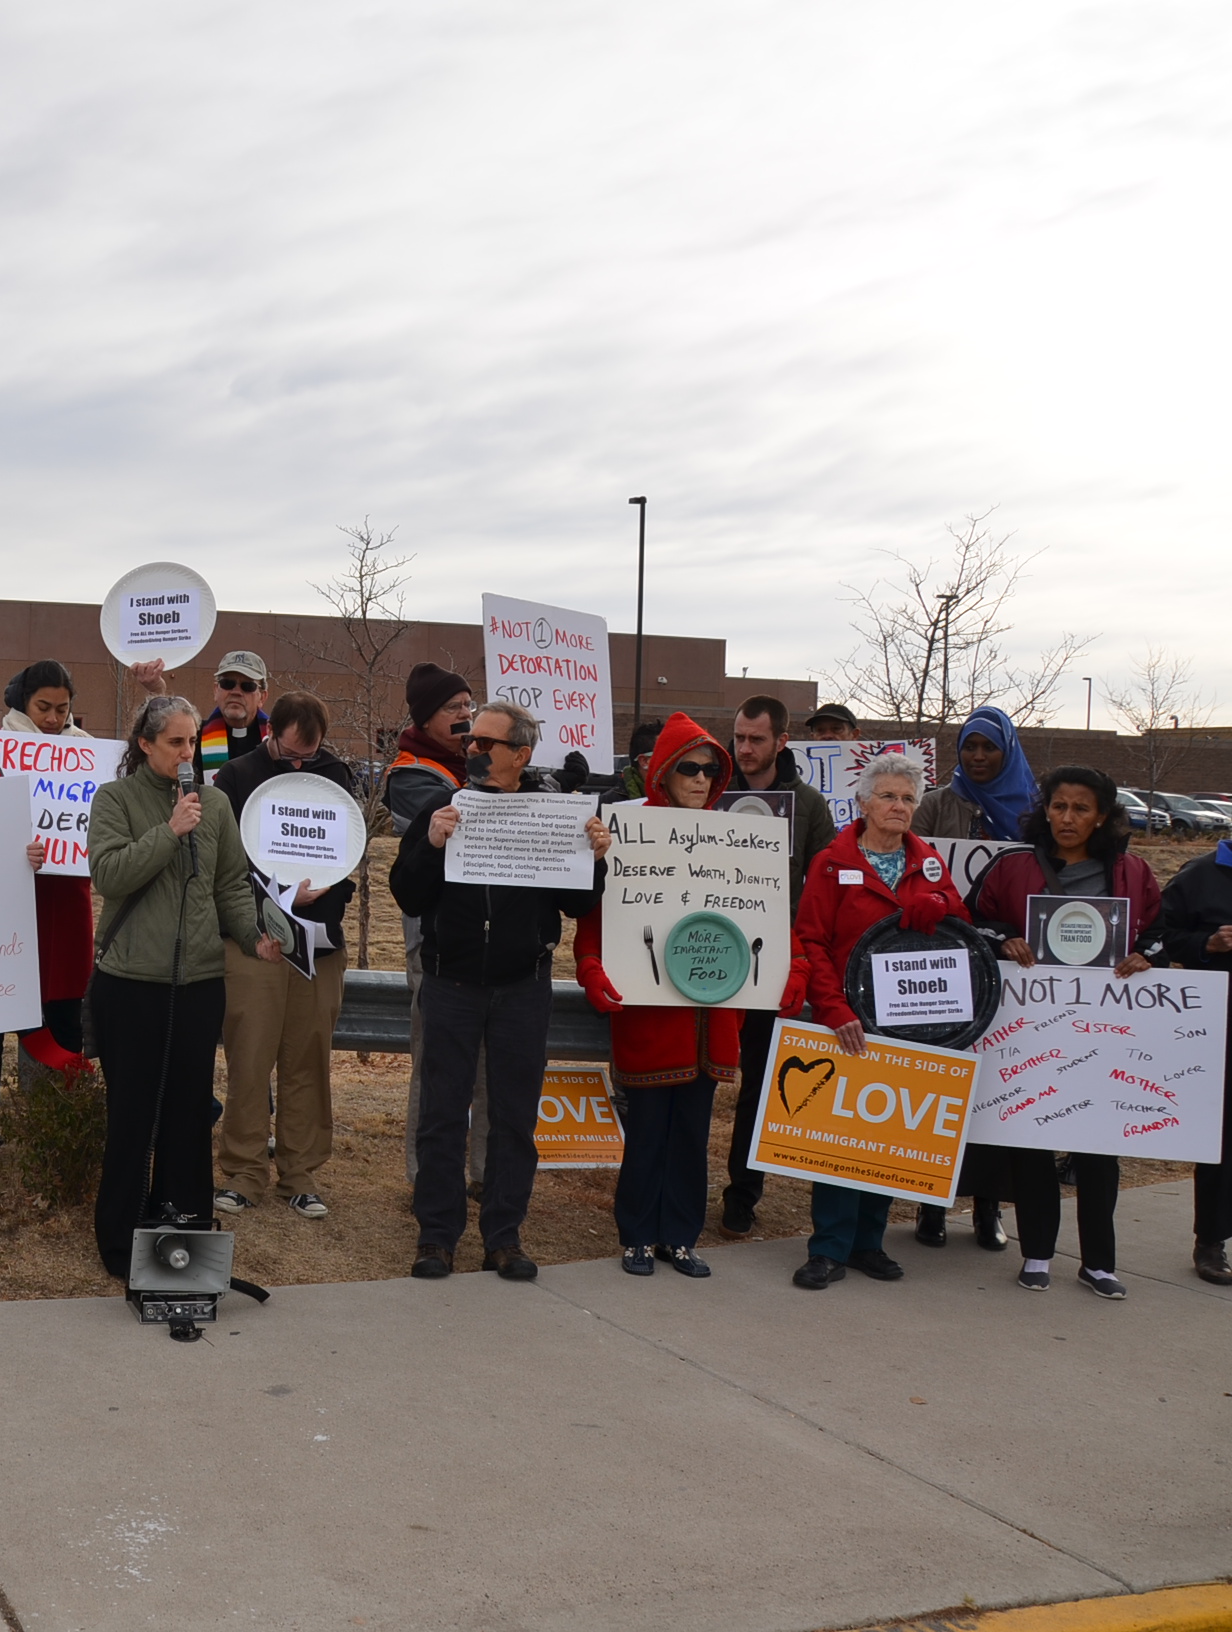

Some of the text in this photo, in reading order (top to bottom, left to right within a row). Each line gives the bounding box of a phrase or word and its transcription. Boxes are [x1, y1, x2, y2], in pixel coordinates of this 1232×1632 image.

[130, 594, 190, 607] I stand with
[138, 610, 180, 625] Shoeb
[490, 616, 531, 641] #NOT
[555, 628, 594, 651] MORE
[497, 653, 598, 682] DEPORTATION
[496, 685, 596, 718] STOP EVERY
[559, 724, 595, 748] ONE!
[33, 778, 96, 803] MIGR
[272, 804, 336, 821] I stand with
[281, 822, 326, 840] Shoeb
[509, 820, 540, 828] detention
[608, 813, 655, 844] ALL
[494, 853, 526, 861] conditions
[613, 856, 781, 891] DESERVE WORTH, DIGNITY,
[621, 888, 664, 904] LOVE
[704, 894, 766, 913] FREEDOM
[687, 930, 724, 943] MORE
[1076, 935, 1092, 943] FOOD
[672, 946, 732, 955] IMPORTANT
[691, 956, 718, 964] THAN
[688, 967, 728, 981] FOOD
[885, 956, 956, 972] I stand with
[897, 977, 947, 995] Shoeb
[1001, 976, 1202, 1013] NOT 1 MORE
[1034, 1009, 1077, 1032] FRIEND
[1072, 1019, 1136, 1037] SISTER
[971, 1017, 1035, 1053] FATHER
[1174, 1026, 1207, 1041] SON
[783, 1035, 969, 1078] STANDIN ON THE SIDE OF
[999, 1048, 1068, 1083] BROTHER
[1056, 1048, 1099, 1075] STUDENT
[563, 1076, 584, 1084] SIDE
[1163, 1065, 1206, 1082] LOVER
[1109, 1068, 1179, 1106] MOTHER
[537, 1096, 613, 1123] OVE
[831, 1075, 963, 1138] LOVE
[1033, 1099, 1095, 1127] DAUGHTER
[1110, 1100, 1172, 1116] TEACHER
[533, 1134, 619, 1142] IGRANT FAMILIES
[1123, 1116, 1180, 1138] GRANDPA
[767, 1121, 952, 1166] WITH IMMIGRANT FAMILIES
[773, 1151, 934, 1190] www.StandingontheSideofLove.org
